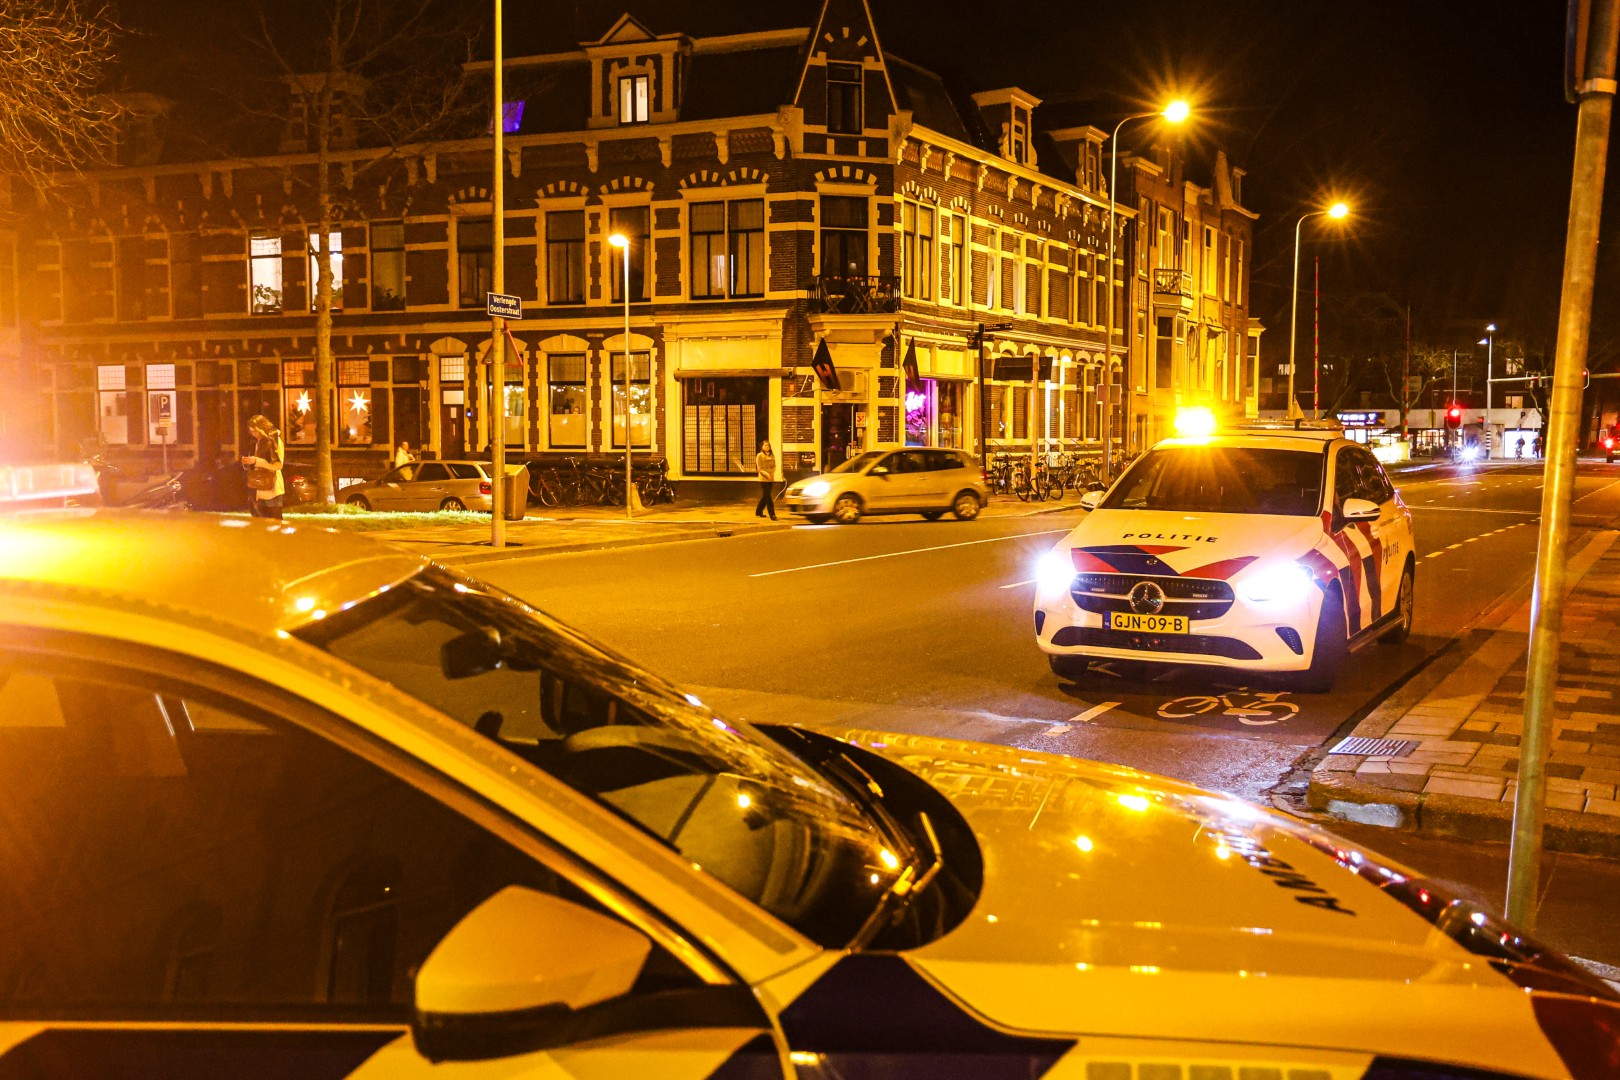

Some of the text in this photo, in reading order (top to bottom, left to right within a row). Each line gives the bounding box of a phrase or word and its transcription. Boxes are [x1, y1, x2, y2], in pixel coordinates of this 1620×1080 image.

[489, 304, 519, 316] Oosterstraat
[161, 396, 168, 408] P
[1122, 533, 1218, 543] POLITIE
[1114, 614, 1183, 631] GJN-09-B
